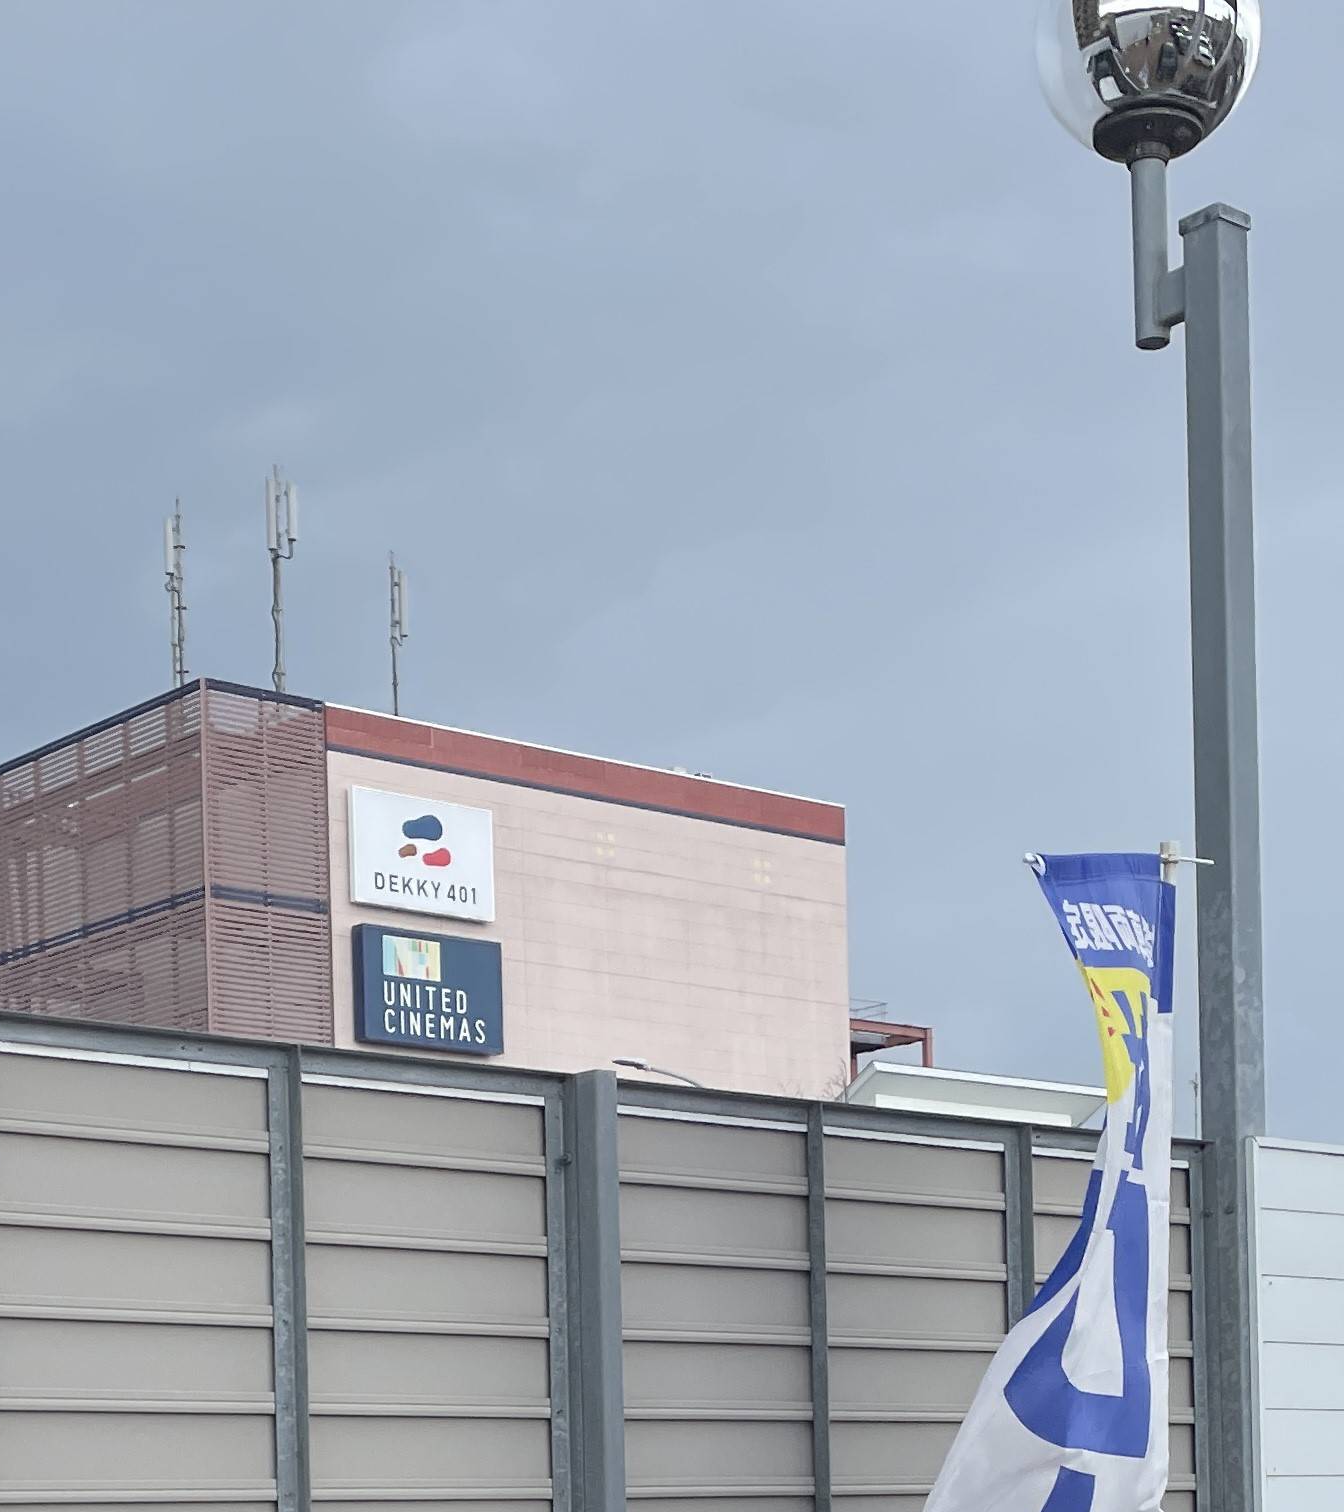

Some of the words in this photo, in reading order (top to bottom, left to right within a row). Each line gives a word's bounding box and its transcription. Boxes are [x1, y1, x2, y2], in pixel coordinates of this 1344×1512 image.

[373, 871, 441, 900] DEKKY
[447, 884, 477, 905] 401
[382, 980, 468, 1015] UNITED
[383, 1008, 487, 1045] CINEMAS
